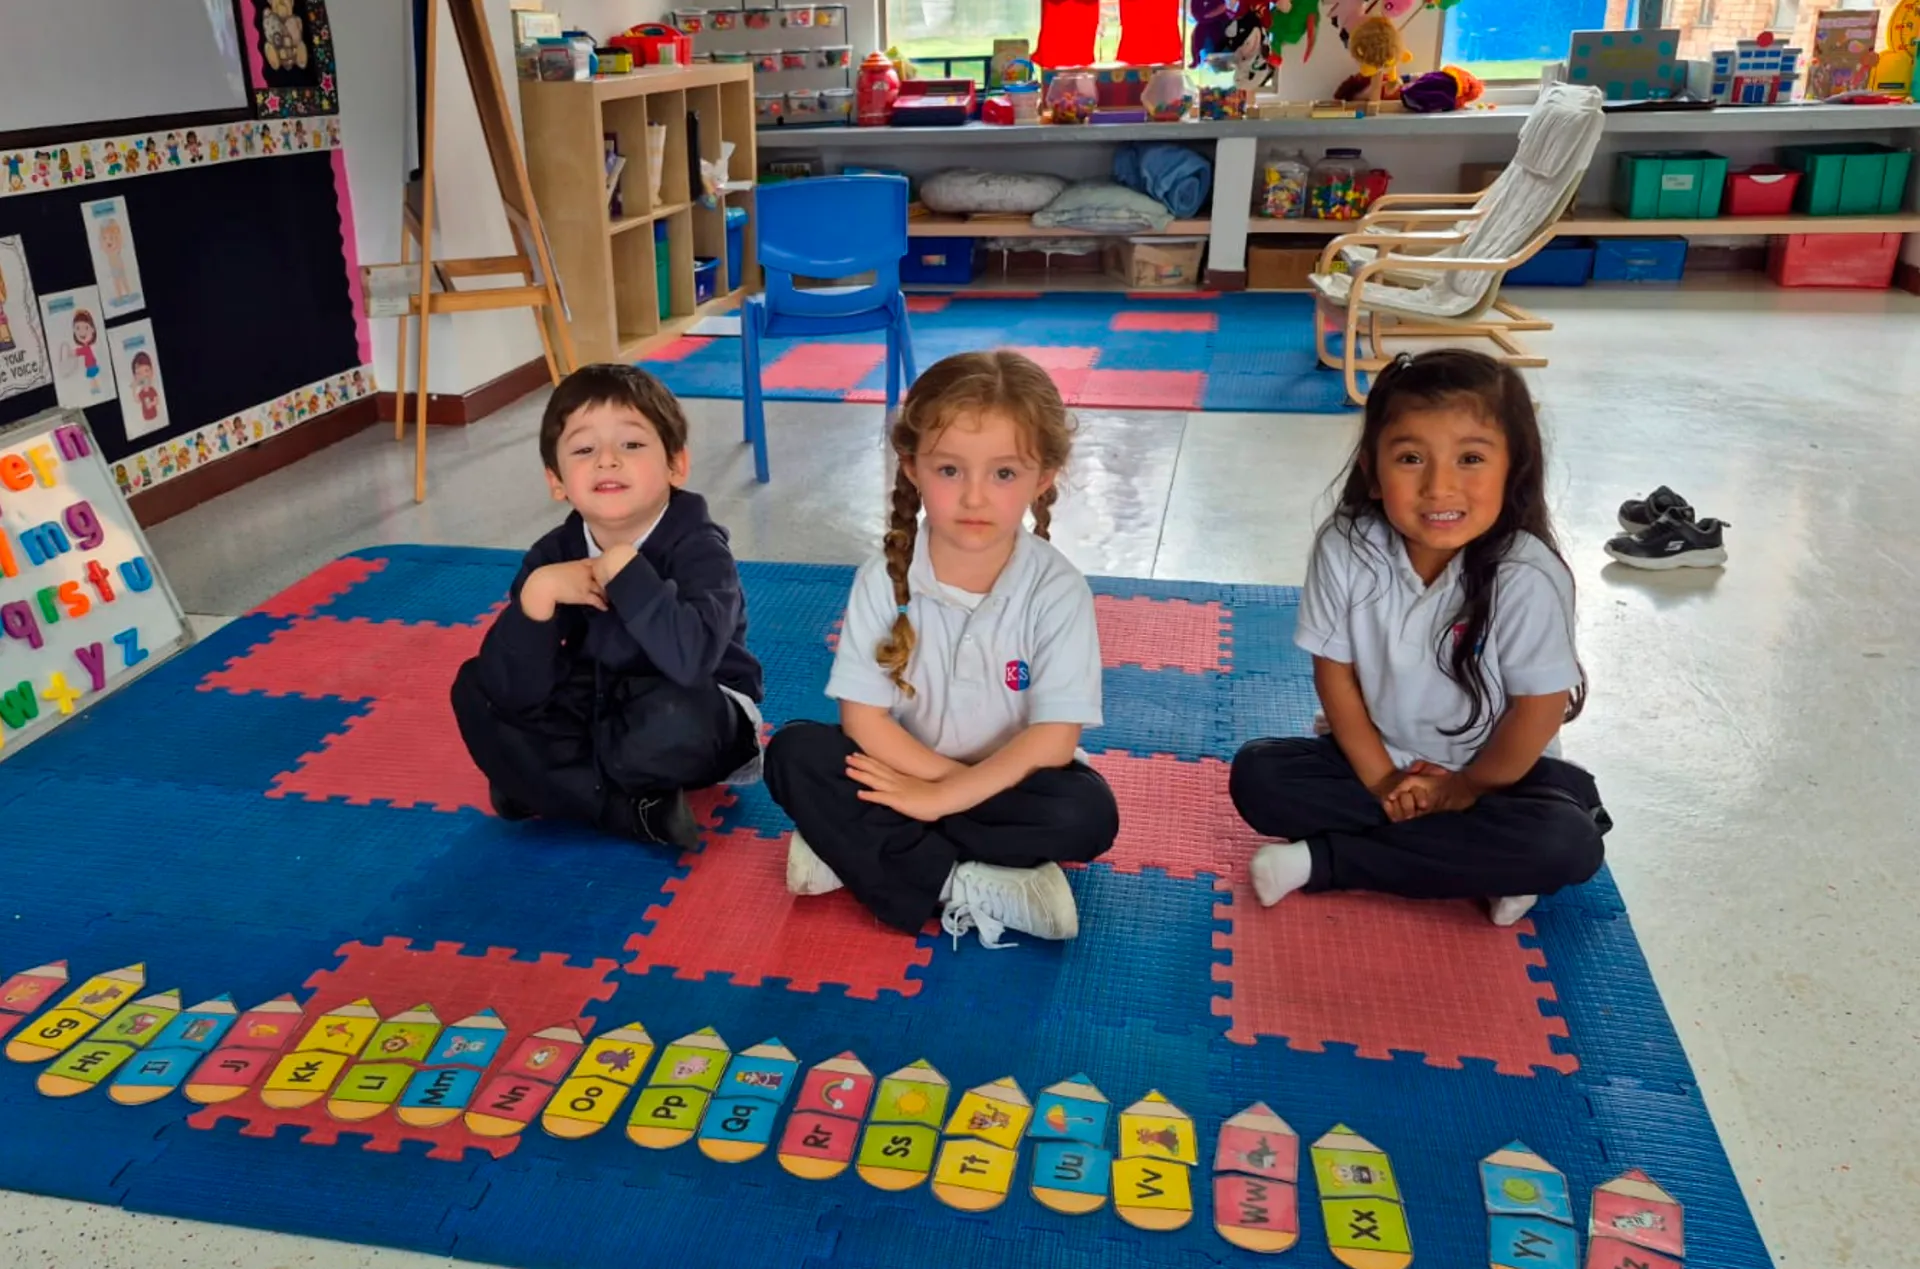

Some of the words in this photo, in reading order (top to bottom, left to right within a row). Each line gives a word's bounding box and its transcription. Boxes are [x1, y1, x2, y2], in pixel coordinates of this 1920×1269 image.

[1007, 666, 1029, 682] KS
[40, 1018, 79, 1040] Gg
[70, 1050, 111, 1074] Hh
[288, 1061, 323, 1082] Kk
[418, 1069, 460, 1106] Mm
[492, 1086, 530, 1111] Nn
[570, 1087, 603, 1112] Oo
[652, 1096, 687, 1119] Pp
[721, 1105, 758, 1133] Qq
[802, 1124, 832, 1149] Rr
[882, 1136, 912, 1157] Ss
[959, 1155, 989, 1174] Tt
[1054, 1155, 1084, 1180] Uu
[1350, 1210, 1381, 1241] Xx
